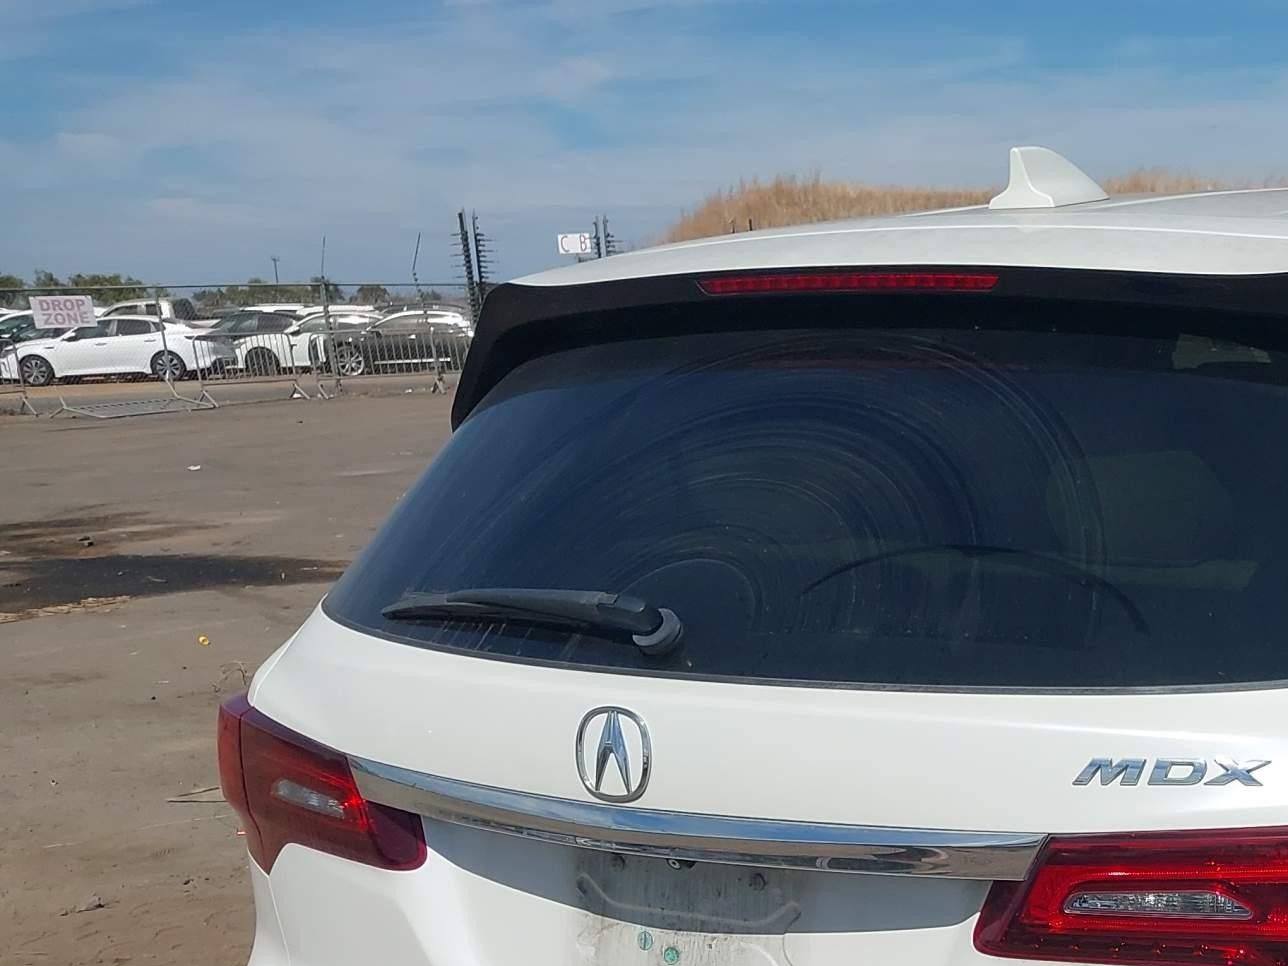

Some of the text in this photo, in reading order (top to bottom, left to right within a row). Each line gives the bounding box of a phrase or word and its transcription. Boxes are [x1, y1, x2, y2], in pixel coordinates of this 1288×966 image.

[38, 299, 85, 311] DROP
[41, 312, 91, 325] ZONE
[1071, 756, 1273, 787] MDX
